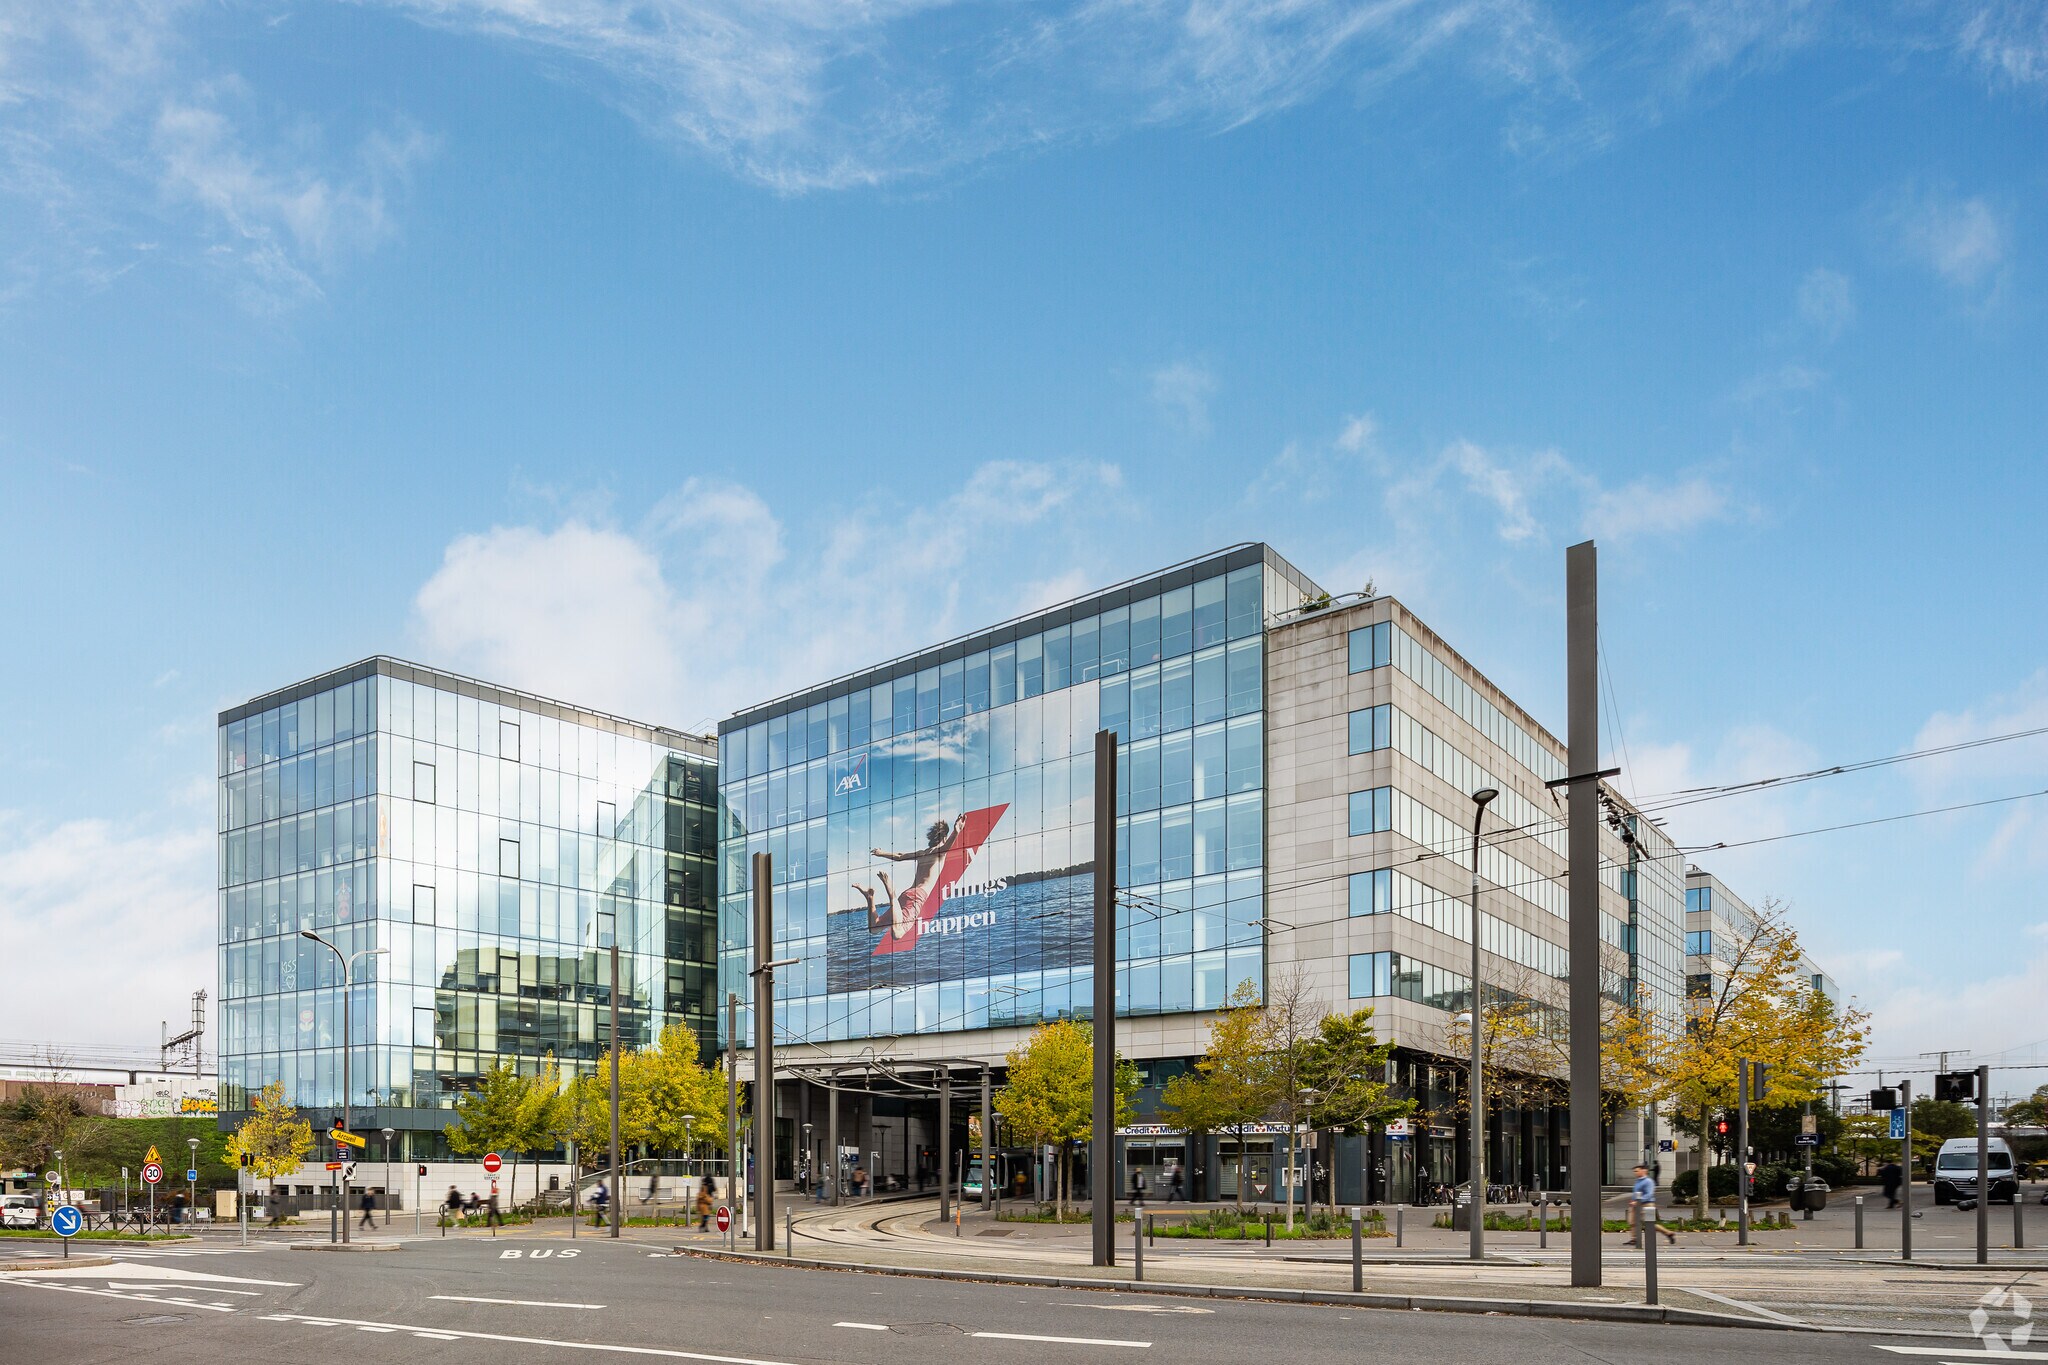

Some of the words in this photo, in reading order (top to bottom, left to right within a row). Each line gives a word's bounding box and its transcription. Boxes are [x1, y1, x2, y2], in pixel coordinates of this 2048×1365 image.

[835, 773, 862, 793] AXA
[941, 877, 1008, 900] things
[916, 910, 997, 937] happen
[281, 960, 296, 973] KISS
[1125, 1126, 1150, 1134] Crédit
[1266, 1124, 1299, 1132] Mutul
[336, 1132, 357, 1143] Arcueil
[147, 1168, 159, 1178] 30
[498, 1248, 582, 1259] BUS
